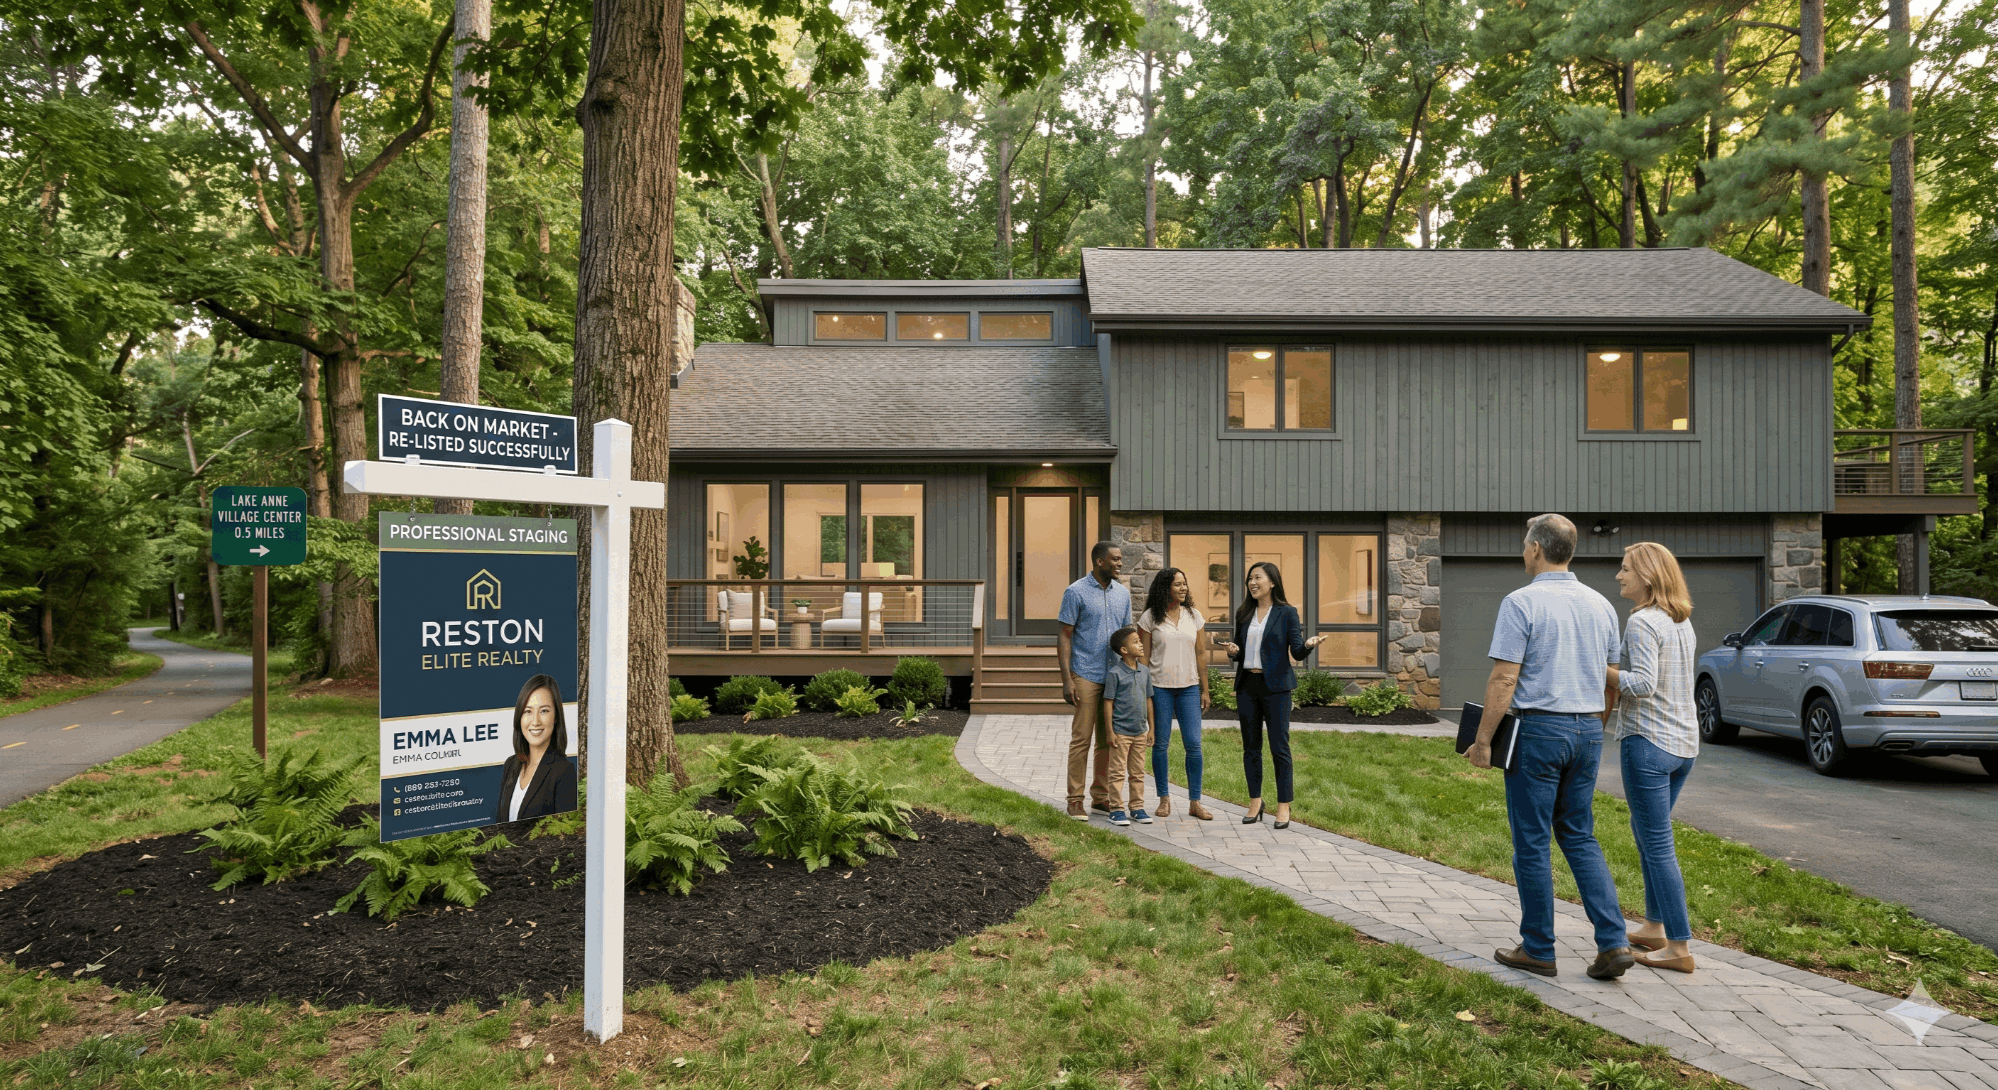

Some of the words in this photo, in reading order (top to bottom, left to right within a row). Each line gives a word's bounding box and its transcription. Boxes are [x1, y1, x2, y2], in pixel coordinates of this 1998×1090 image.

[401, 408, 449, 430] BACK
[453, 414, 479, 433] ON
[484, 417, 550, 440] MARKET
[389, 431, 465, 452] RE-LISTED
[468, 438, 570, 461] SUCCESSFULLY
[231, 494, 258, 507] LAKE
[261, 495, 289, 507] ANNE
[217, 510, 260, 523] VILLAGE
[263, 511, 302, 523] CENTER
[234, 526, 251, 539] 0.5
[255, 527, 285, 539] MILES
[390, 524, 505, 542] PROFESSIONAL
[509, 528, 568, 544] STAGING
[422, 618, 543, 648] RESTON
[422, 652, 472, 670] ELITE
[478, 649, 544, 667] REALTY
[393, 727, 457, 751] EMMA
[463, 723, 499, 743] LEE
[392, 753, 422, 765] EMMA
